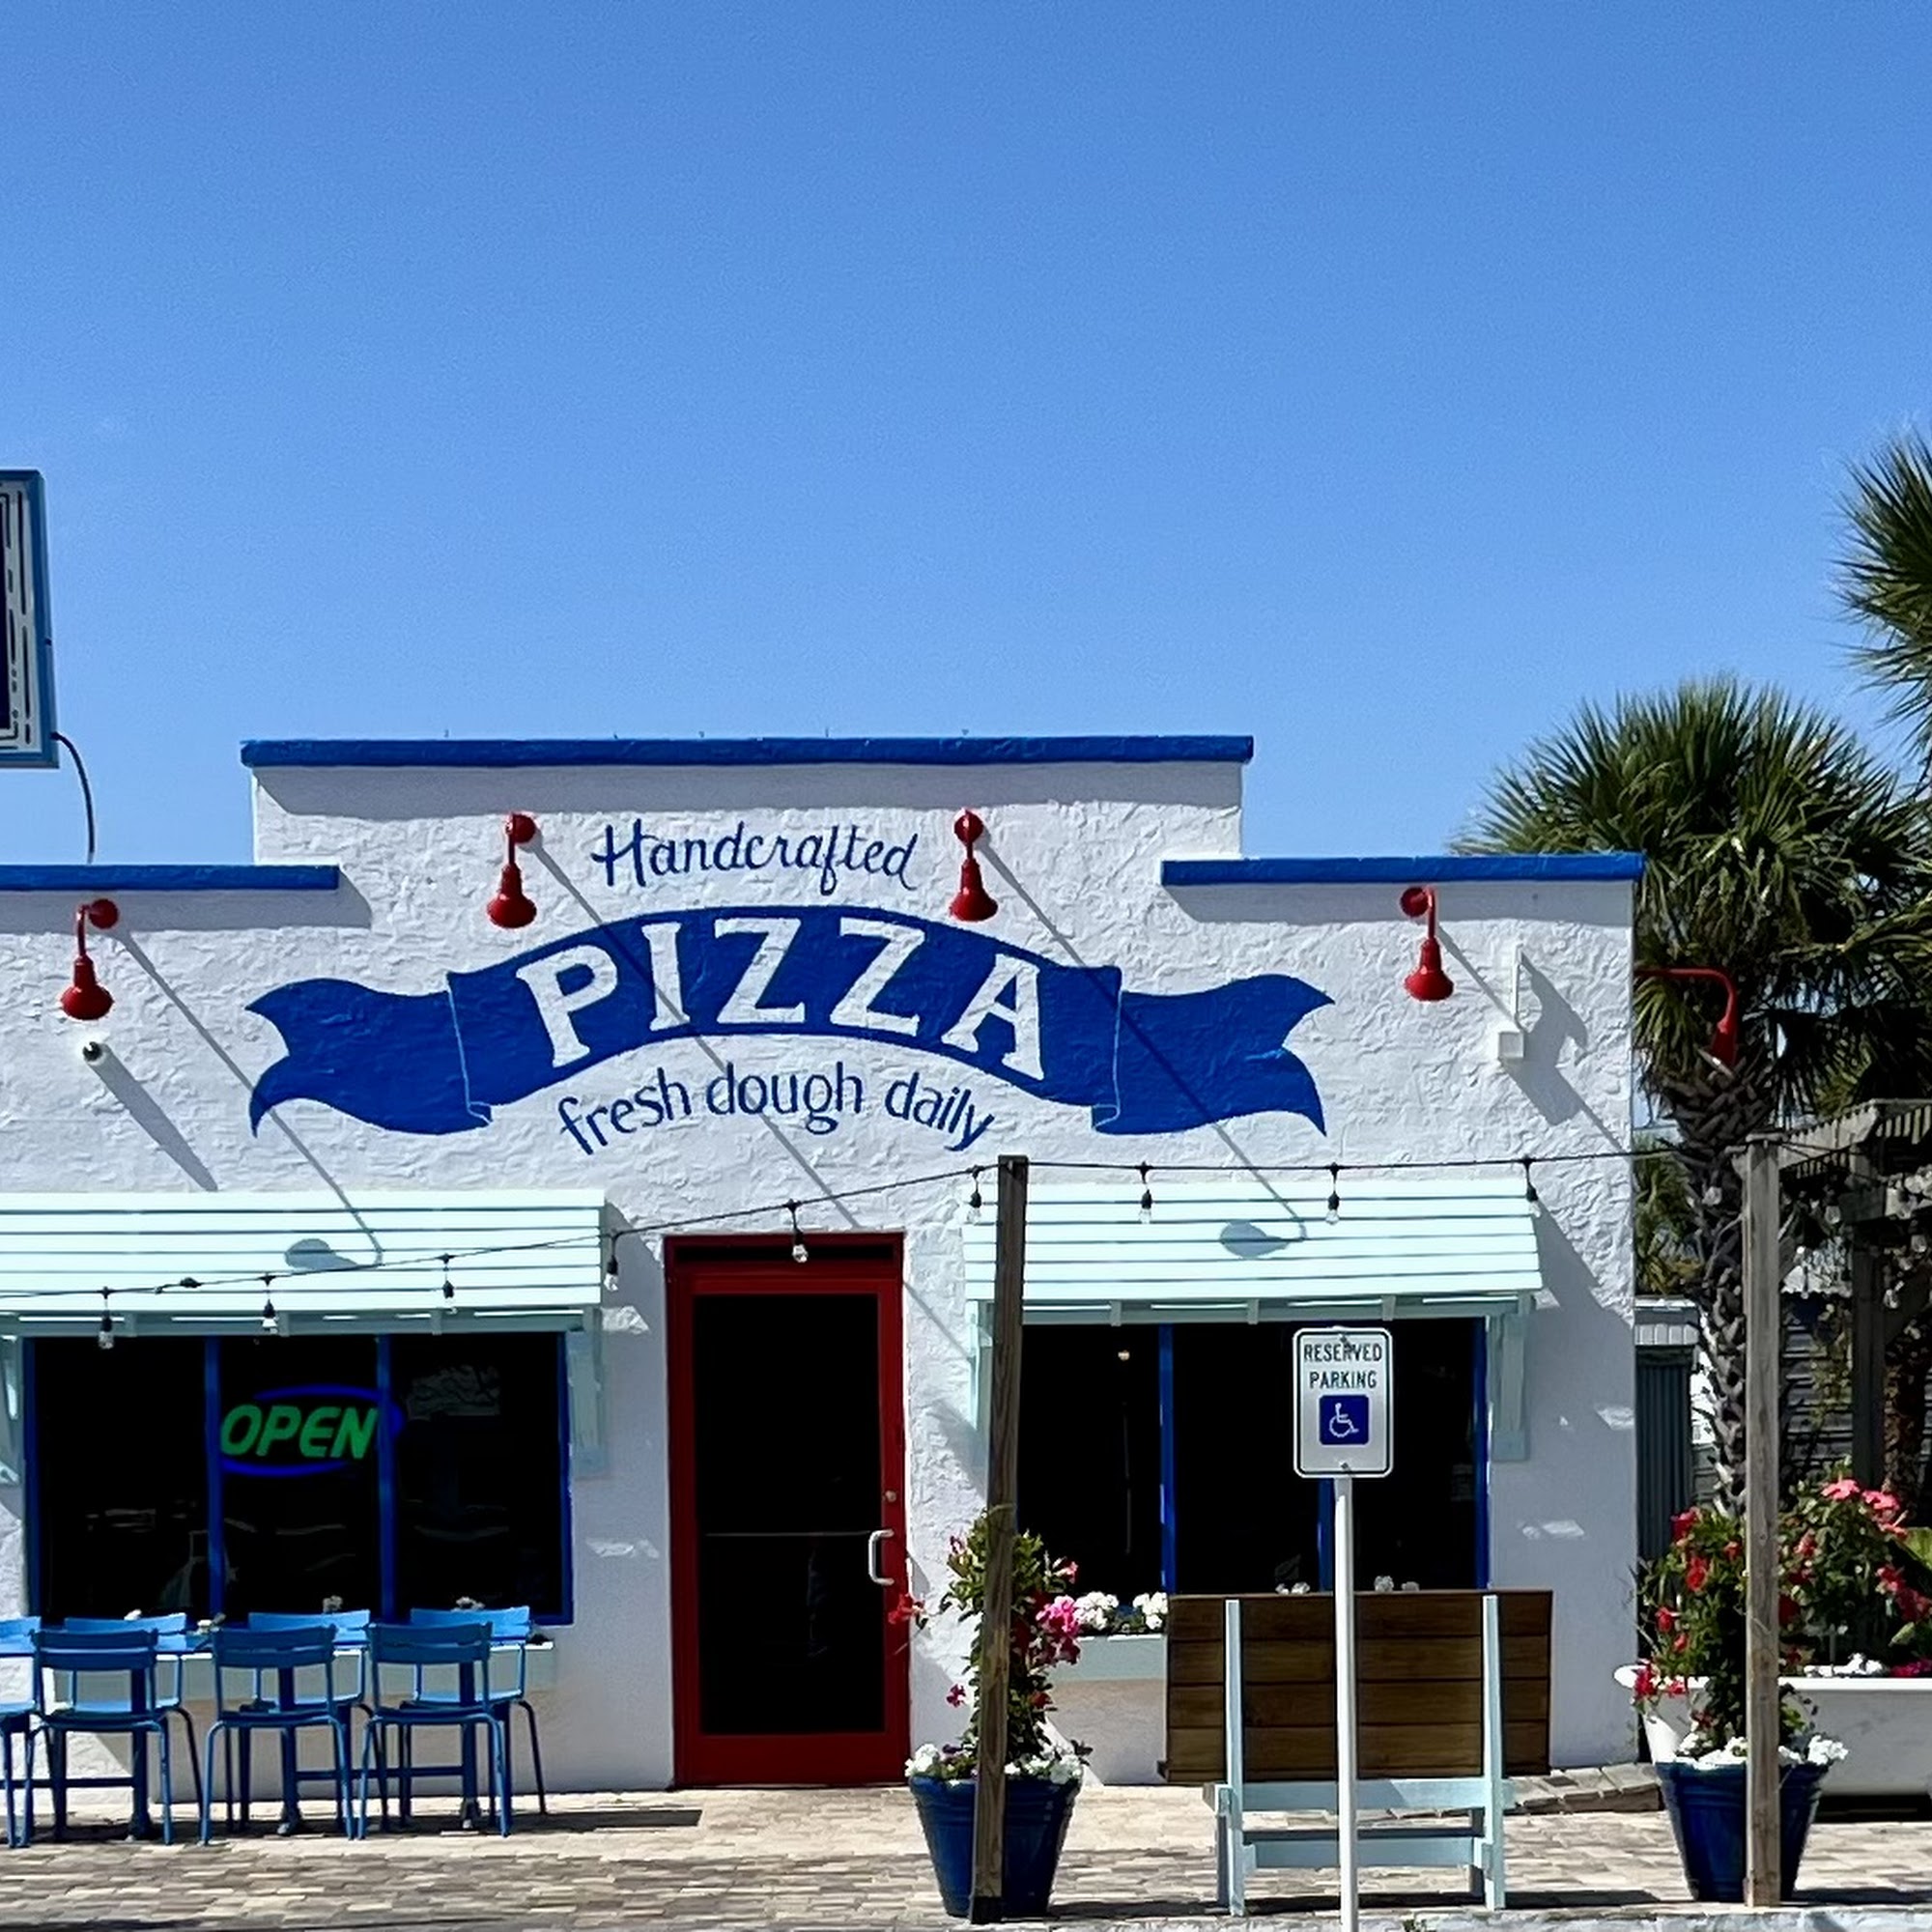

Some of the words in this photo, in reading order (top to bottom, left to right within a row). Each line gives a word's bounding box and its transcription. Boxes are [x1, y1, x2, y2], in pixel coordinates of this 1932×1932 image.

[590, 818, 918, 895] Handcrafted
[516, 917, 1043, 1080] PIZZA
[557, 1067, 692, 1154] fresh
[706, 1062, 862, 1135] dough
[885, 1071, 995, 1151] daily
[1303, 1342, 1383, 1362] RESERVED
[1309, 1370, 1378, 1389] PARKING
[218, 1404, 380, 1460] OPEN
